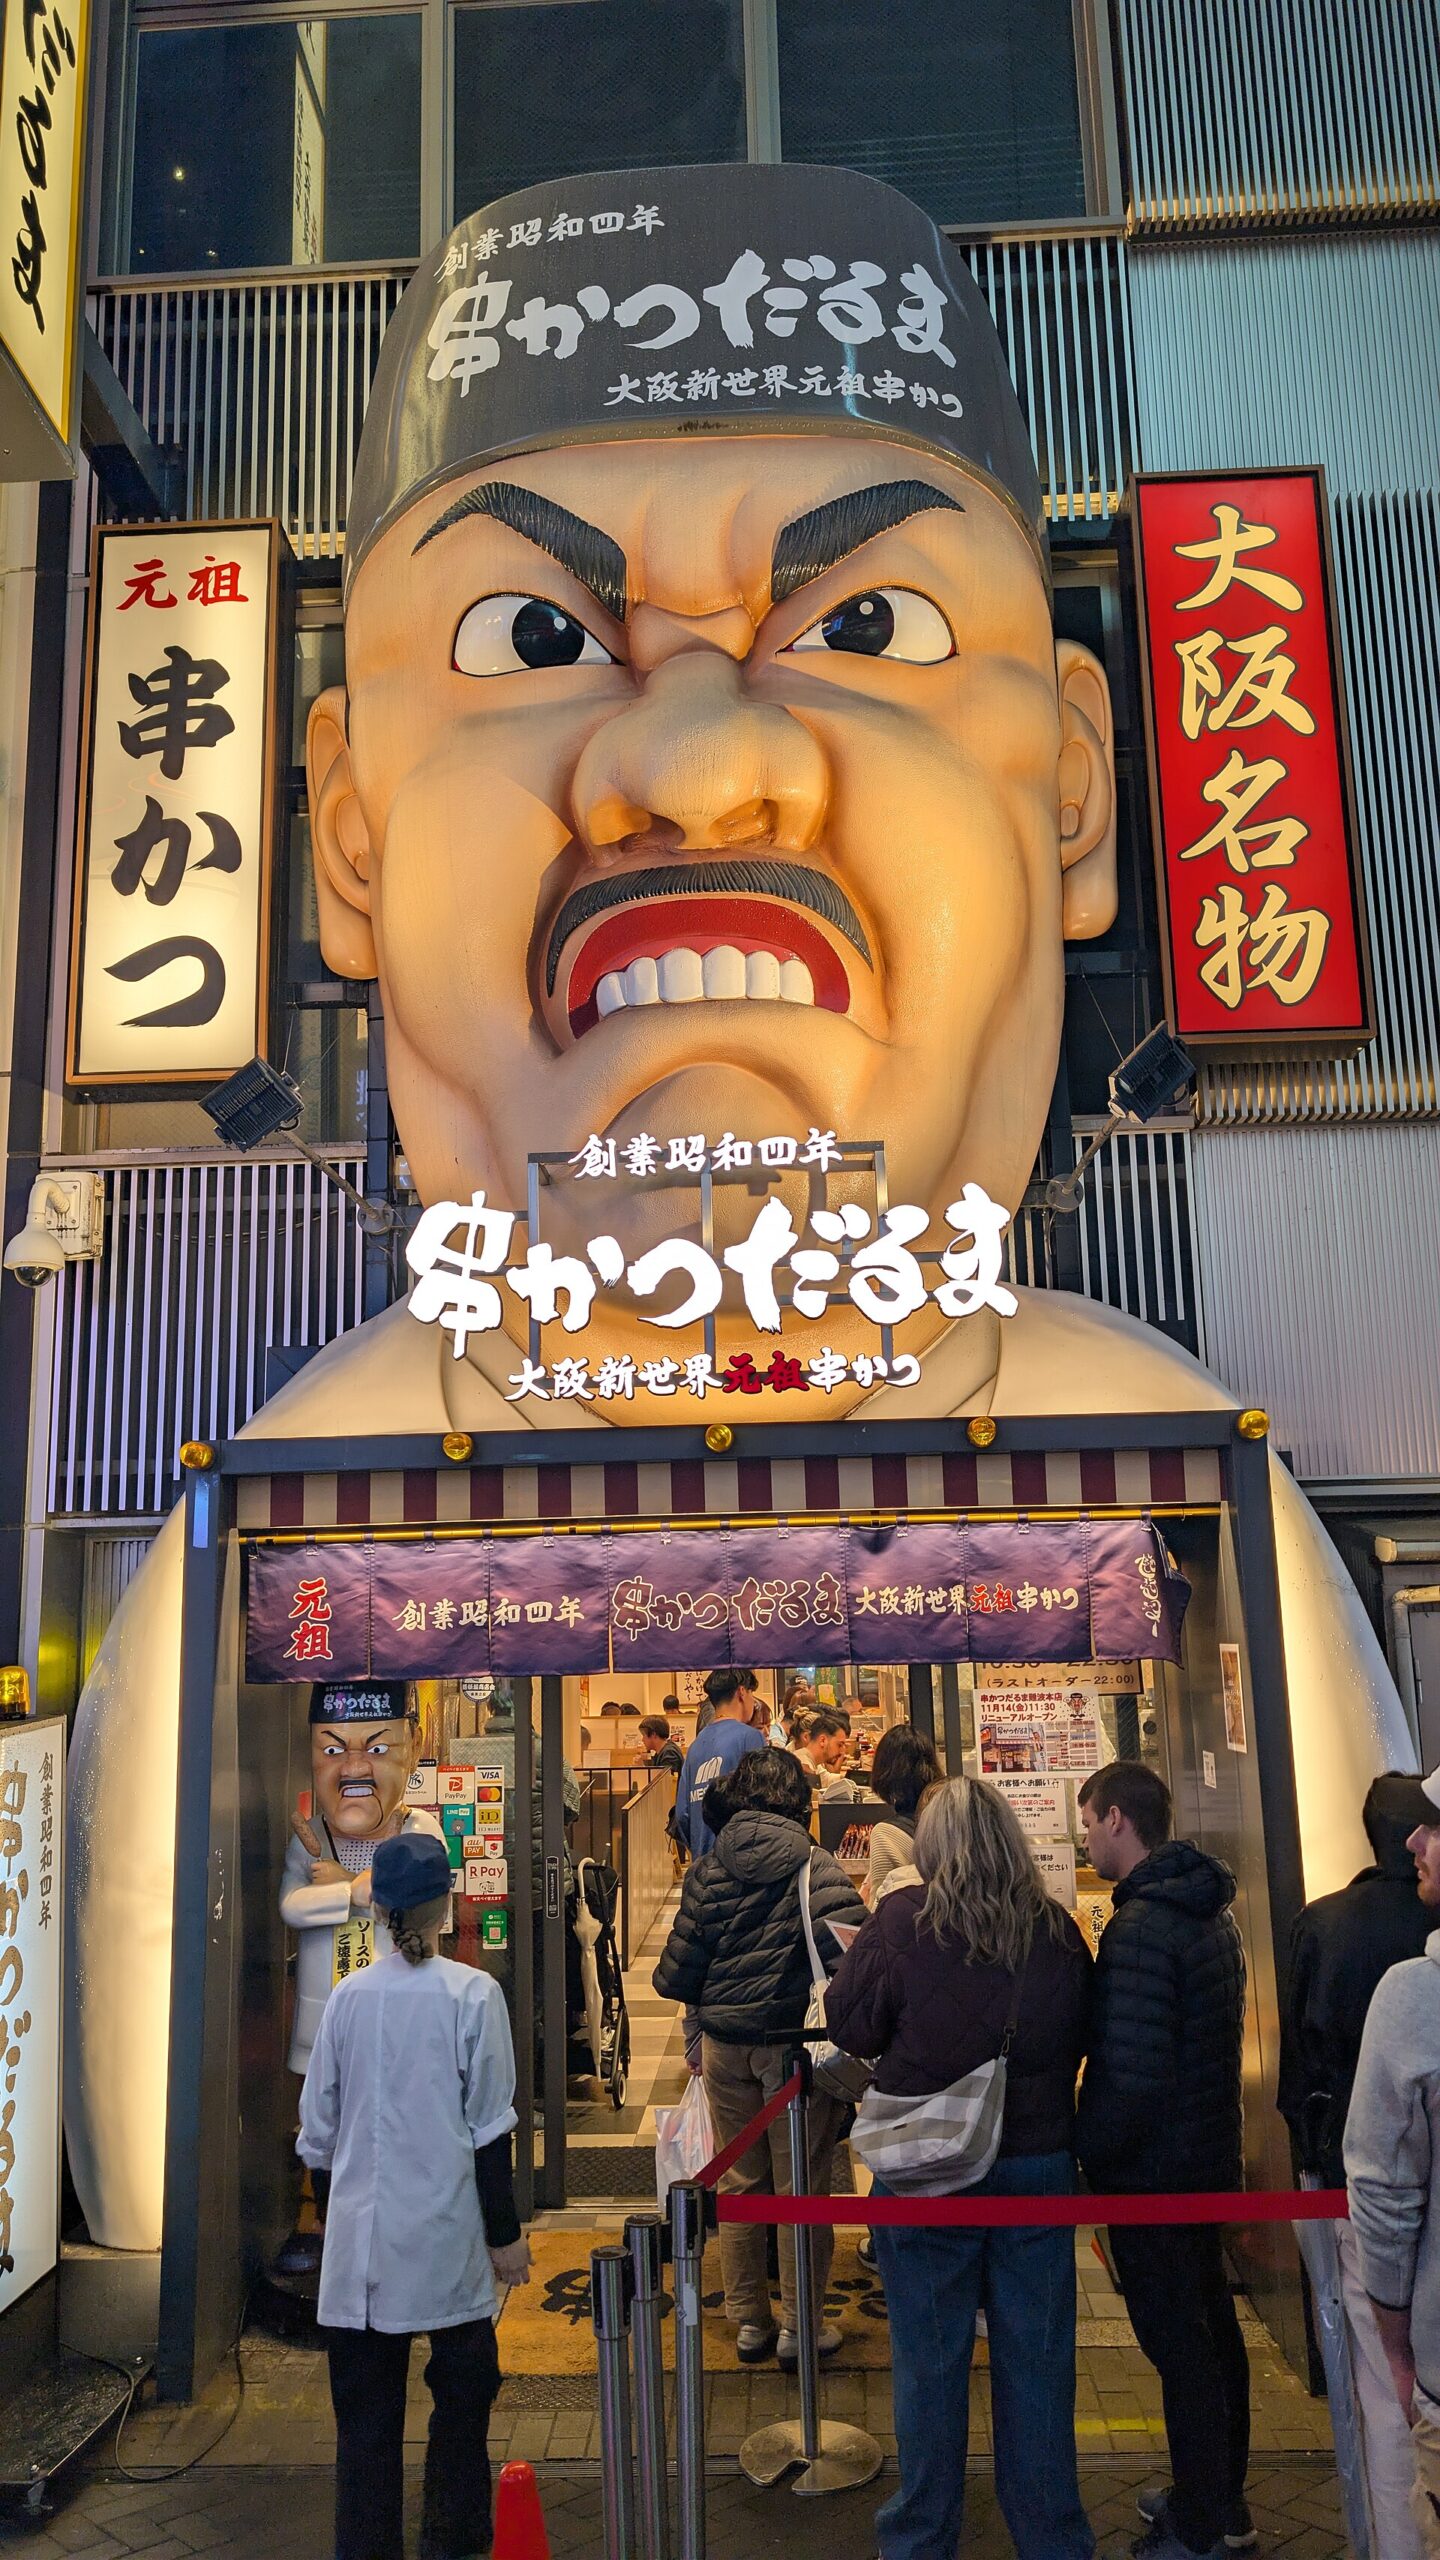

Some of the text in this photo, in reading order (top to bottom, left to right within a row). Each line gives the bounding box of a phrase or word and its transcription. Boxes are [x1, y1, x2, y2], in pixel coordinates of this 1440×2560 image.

[434, 203, 666, 284] 創業昭和四年
[427, 248, 957, 399] 串かつだるま
[603, 366, 964, 419] 大阪新世界元祖串かつ
[115, 556, 250, 612] 元祖
[1172, 502, 1331, 1009] 大阪名物
[102, 644, 243, 1028] 串かつ
[570, 1127, 845, 1179] 創業昭和四年
[405, 1182, 1020, 1360] 串かつだるま
[503, 1347, 922, 1402] 大阪新世界元祖串かつ
[282, 1576, 334, 1662] 元祖
[392, 1594, 586, 1633] 創業昭和四年
[612, 1571, 845, 1642] 串かつだるま
[854, 1581, 1080, 1617] 大阪新世界元祖串かつ
[980, 1692, 1063, 1702] 串かつだるま難波本店
[981, 1702, 1056, 1713] 11月14(金)11:30
[987, 1675, 1135, 1688] (ラストオーダー22:00)
[981, 1712, 1058, 1723] リニューアルオープン
[480, 1771, 500, 1779] VISA
[997, 1779, 1050, 1788] お客様へお願い
[38, 1751, 53, 1930] 創業昭和四年
[469, 1866, 504, 1879] R Pay
[1041, 1863, 1068, 1872] ください
[356, 1920, 370, 1969] ソースの
